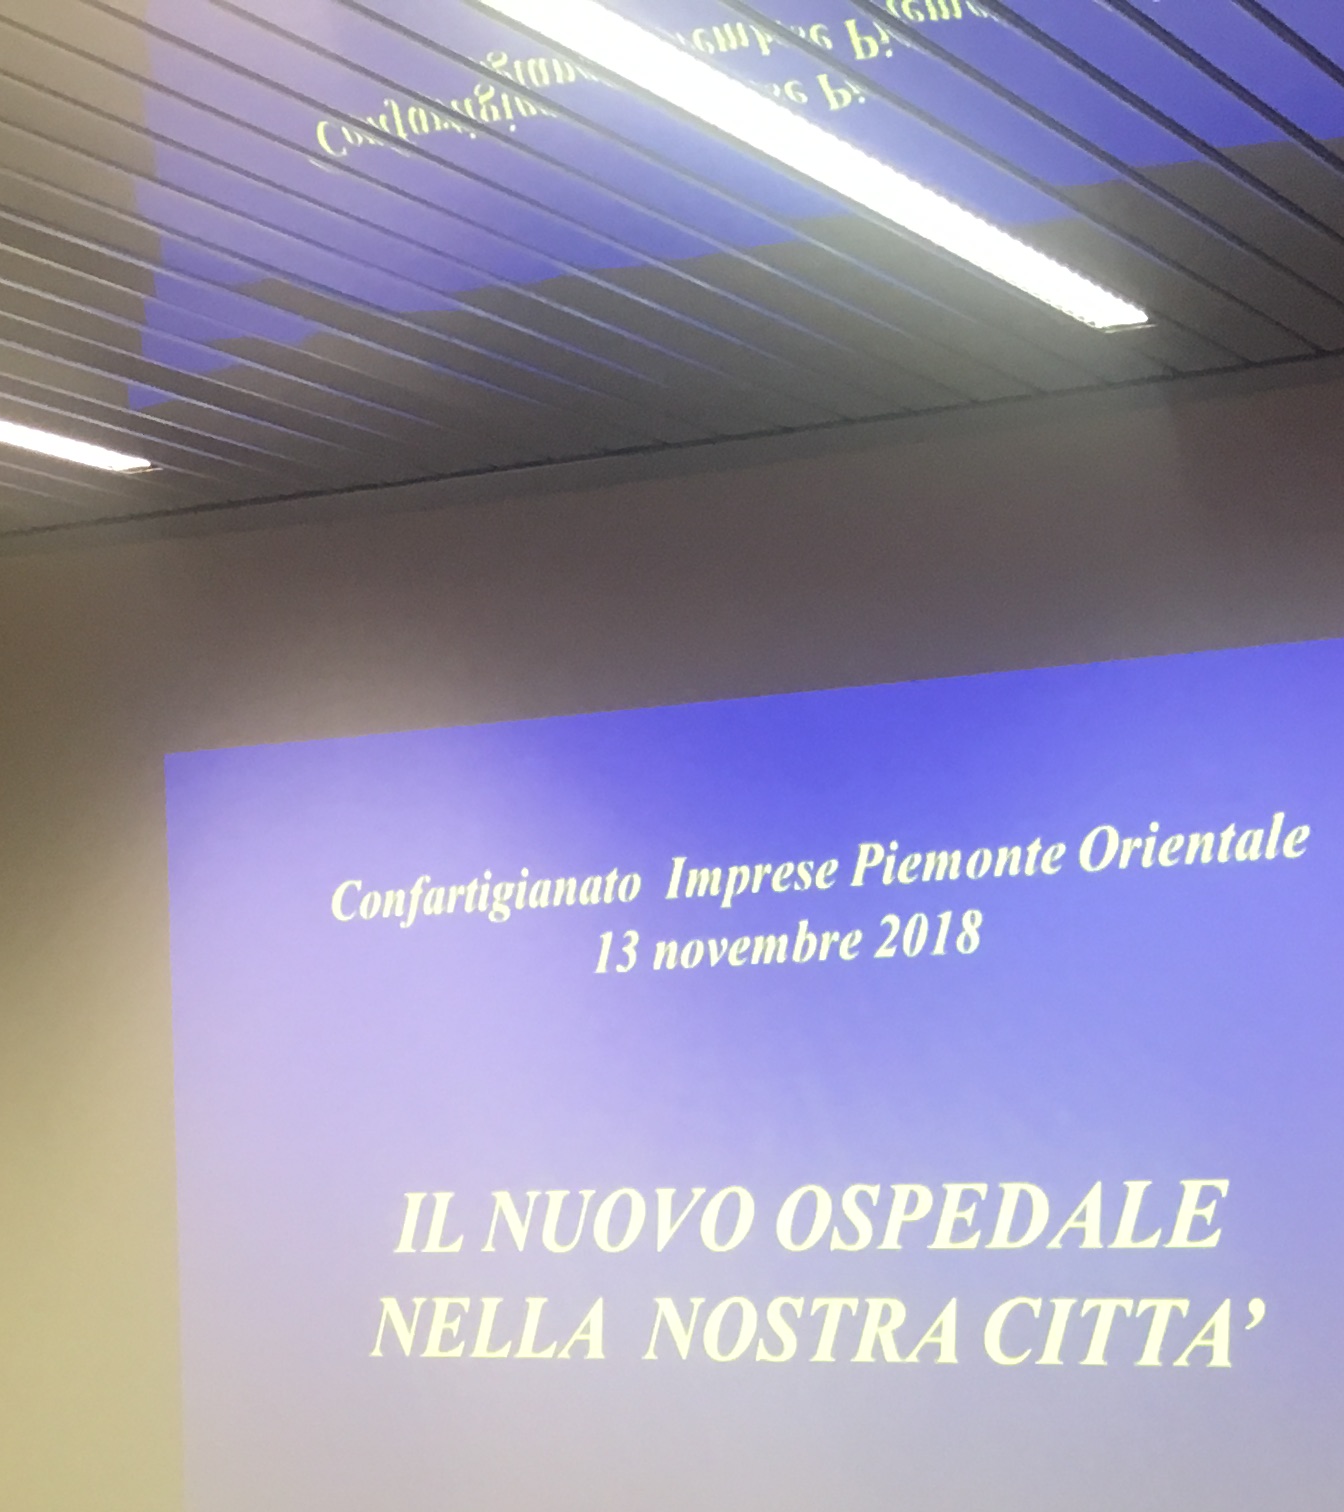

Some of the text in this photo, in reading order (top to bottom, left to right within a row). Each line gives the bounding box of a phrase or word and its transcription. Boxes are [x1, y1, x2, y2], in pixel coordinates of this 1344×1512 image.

[330, 811, 1312, 929] Confartigianato Imprese Piemonte Orientale
[593, 908, 984, 975] 13 novembre 2018
[393, 1177, 1231, 1254] IL NUOVO OSPEDALE
[369, 1296, 606, 1360] NELLA
[641, 1295, 959, 1365] NOSTRA
